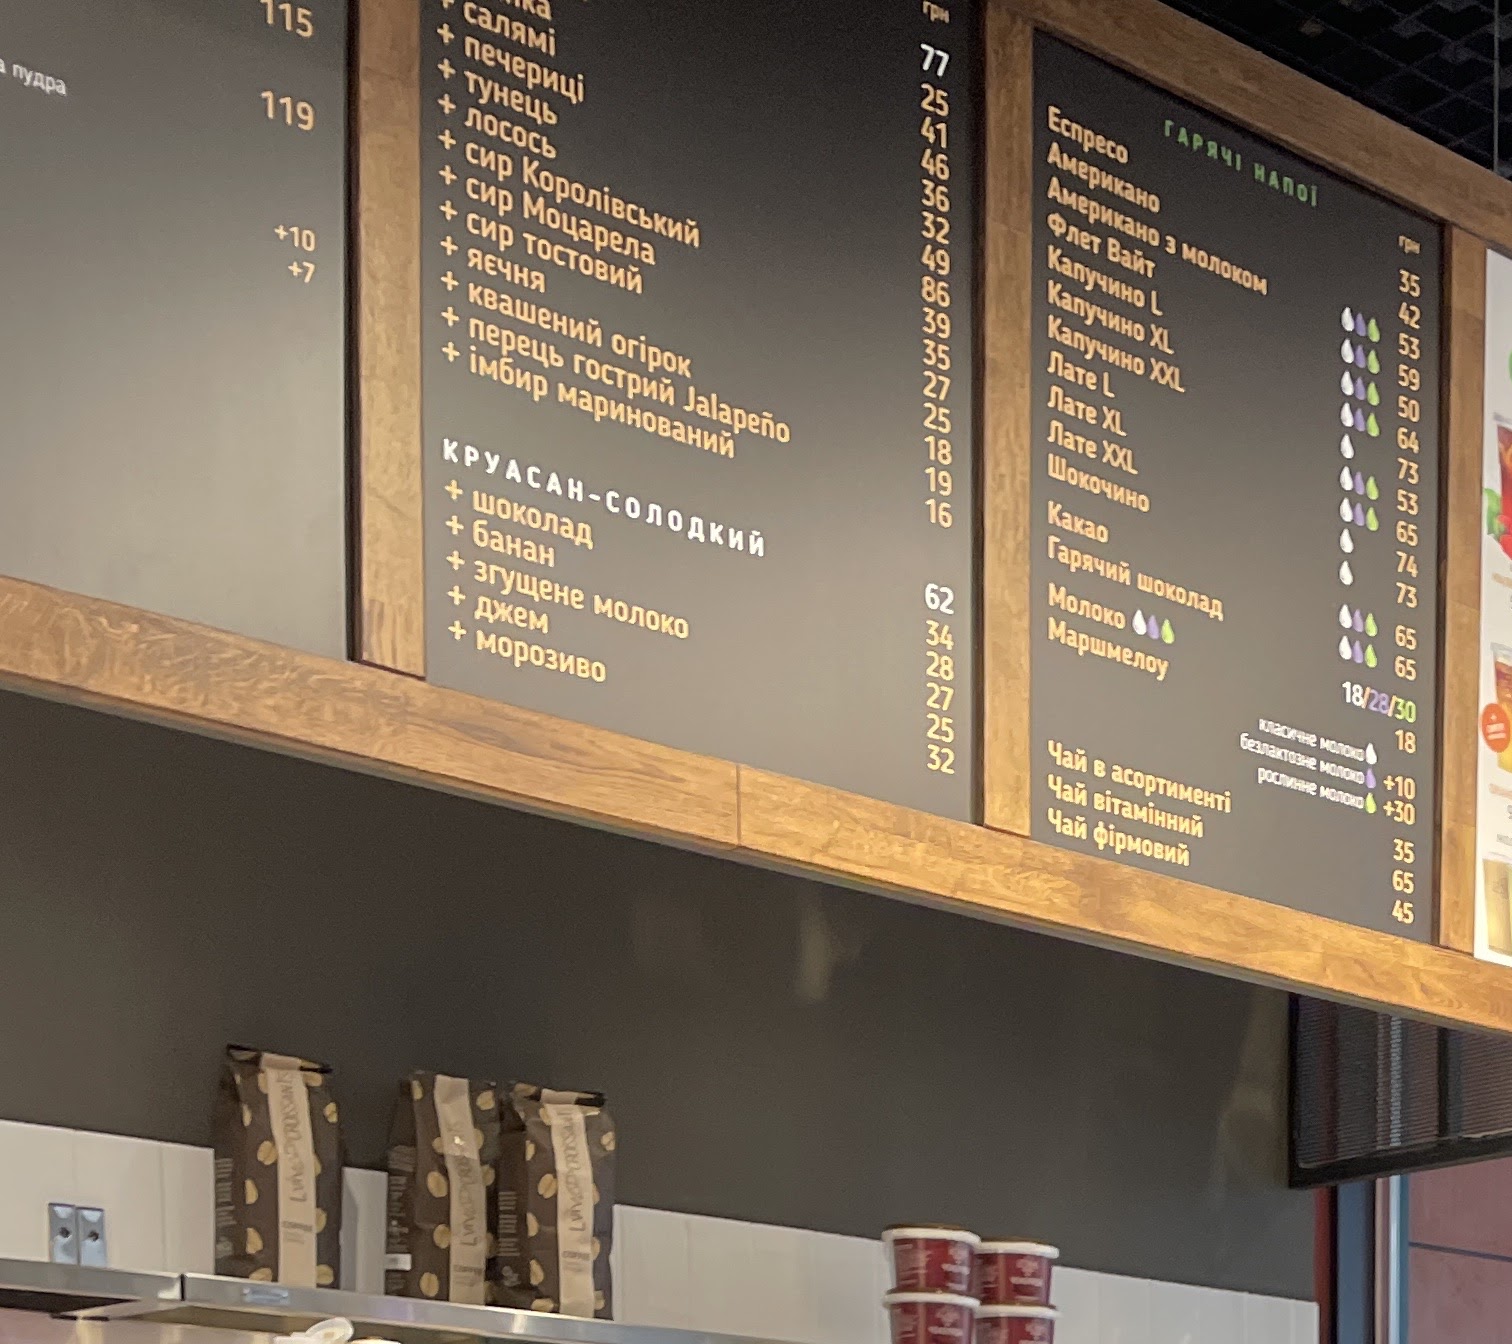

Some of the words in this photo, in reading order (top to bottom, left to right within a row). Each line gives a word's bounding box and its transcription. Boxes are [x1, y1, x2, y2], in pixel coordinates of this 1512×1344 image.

[260, 0, 313, 38] 115
[464, 1, 555, 57] салямі
[464, 35, 583, 106] печериці
[921, 43, 949, 77] 77
[13, 64, 66, 96] пудра
[261, 91, 314, 130] 119
[464, 69, 558, 127] тунець
[921, 83, 949, 116] 25
[464, 108, 556, 160] лосось
[921, 116, 947, 149] 41
[1048, 106, 1128, 163] Еспресо
[921, 148, 949, 180] 46
[1048, 142, 1160, 213] Американо
[1165, 120, 1240, 170] ГАРЯЧІ
[1255, 164, 1316, 206] НАПОЇ
[466, 143, 512, 181] сир
[522, 157, 701, 248] Королівський
[922, 180, 949, 212] 36
[275, 225, 315, 251] +10
[467, 178, 513, 217] сир
[523, 190, 655, 267] Моцарела
[922, 211, 949, 244] 32
[1048, 177, 1159, 246] Американо
[1165, 236, 1176, 254] з
[1182, 243, 1267, 295] молоком
[467, 213, 513, 251] сир
[523, 231, 642, 294] тостовий
[922, 244, 950, 275] 49
[1048, 213, 1101, 254] Флет
[1108, 238, 1155, 278] Вайт
[288, 262, 314, 283] +7
[468, 248, 545, 293] яєчня
[1049, 246, 1145, 307] Капучино
[1151, 290, 1163, 316] L
[1399, 269, 1420, 297] 35
[922, 276, 950, 307] 86
[469, 283, 601, 350] квашений
[612, 334, 691, 378] огірок
[923, 307, 950, 338] 39
[1049, 280, 1145, 341] Капучино
[1150, 324, 1174, 354] XL
[1399, 302, 1420, 329] 42
[923, 339, 950, 370] 35
[1049, 315, 1145, 375] Капучино
[1150, 358, 1185, 392] XXL
[1399, 333, 1420, 359] 53
[470, 315, 565, 369] перець
[573, 352, 675, 407] гострий
[683, 386, 789, 445] Jalapeño
[923, 371, 950, 400] 27
[1048, 351, 1097, 390] Лате
[1103, 372, 1115, 397] L
[1398, 364, 1420, 390] 59
[470, 344, 549, 401] імбир
[558, 383, 734, 458] маринований
[1048, 386, 1097, 424] Лате
[1102, 406, 1127, 436] XL
[1398, 396, 1419, 422] 50
[924, 403, 951, 433] 25
[924, 436, 952, 465] 18
[1048, 420, 1097, 458] Лате
[1102, 440, 1138, 474] XXL
[1398, 427, 1419, 453] 64
[925, 467, 952, 496] 19
[1049, 454, 1149, 512] Шокочино
[1398, 458, 1418, 484] 73
[444, 437, 763, 559] КРУАСАН-СОЛОДКИЙ
[925, 499, 952, 527] 16
[1397, 489, 1418, 515] 53
[473, 491, 593, 549] шоколад
[1049, 501, 1108, 542] Какао
[1397, 521, 1418, 546] 65
[473, 519, 556, 569] банан
[1049, 536, 1130, 585] Гарячий
[1137, 573, 1223, 621] шоколад
[1397, 551, 1418, 577] 74
[474, 561, 584, 609] згущене
[594, 595, 688, 638] молоко
[926, 584, 953, 614] 62
[1049, 583, 1125, 628] Молоко
[1396, 582, 1417, 608] 73
[475, 596, 548, 633] джем
[926, 620, 953, 650] 34
[1049, 616, 1171, 680] Маршмелоу
[1396, 625, 1416, 650] 65
[477, 630, 605, 681] морозиво
[927, 651, 953, 680] 28
[1395, 656, 1416, 680] 65
[927, 683, 953, 710] 27
[1342, 682, 1415, 722] 18/28/30
[927, 713, 954, 742] 25
[1395, 730, 1415, 753] 18
[927, 744, 954, 774] 32
[1048, 740, 1087, 772] Чай
[1094, 760, 1106, 777] в
[1112, 765, 1230, 813] асортименті
[1384, 776, 1415, 799] +10
[1048, 774, 1087, 806] Чай
[1094, 790, 1203, 837] вітамінний
[1383, 800, 1415, 825] +30
[1049, 808, 1087, 839] Чай
[1094, 821, 1189, 866] фірмовий
[1394, 839, 1414, 863] 35
[1393, 870, 1414, 893] 65
[1392, 900, 1413, 923] 45
